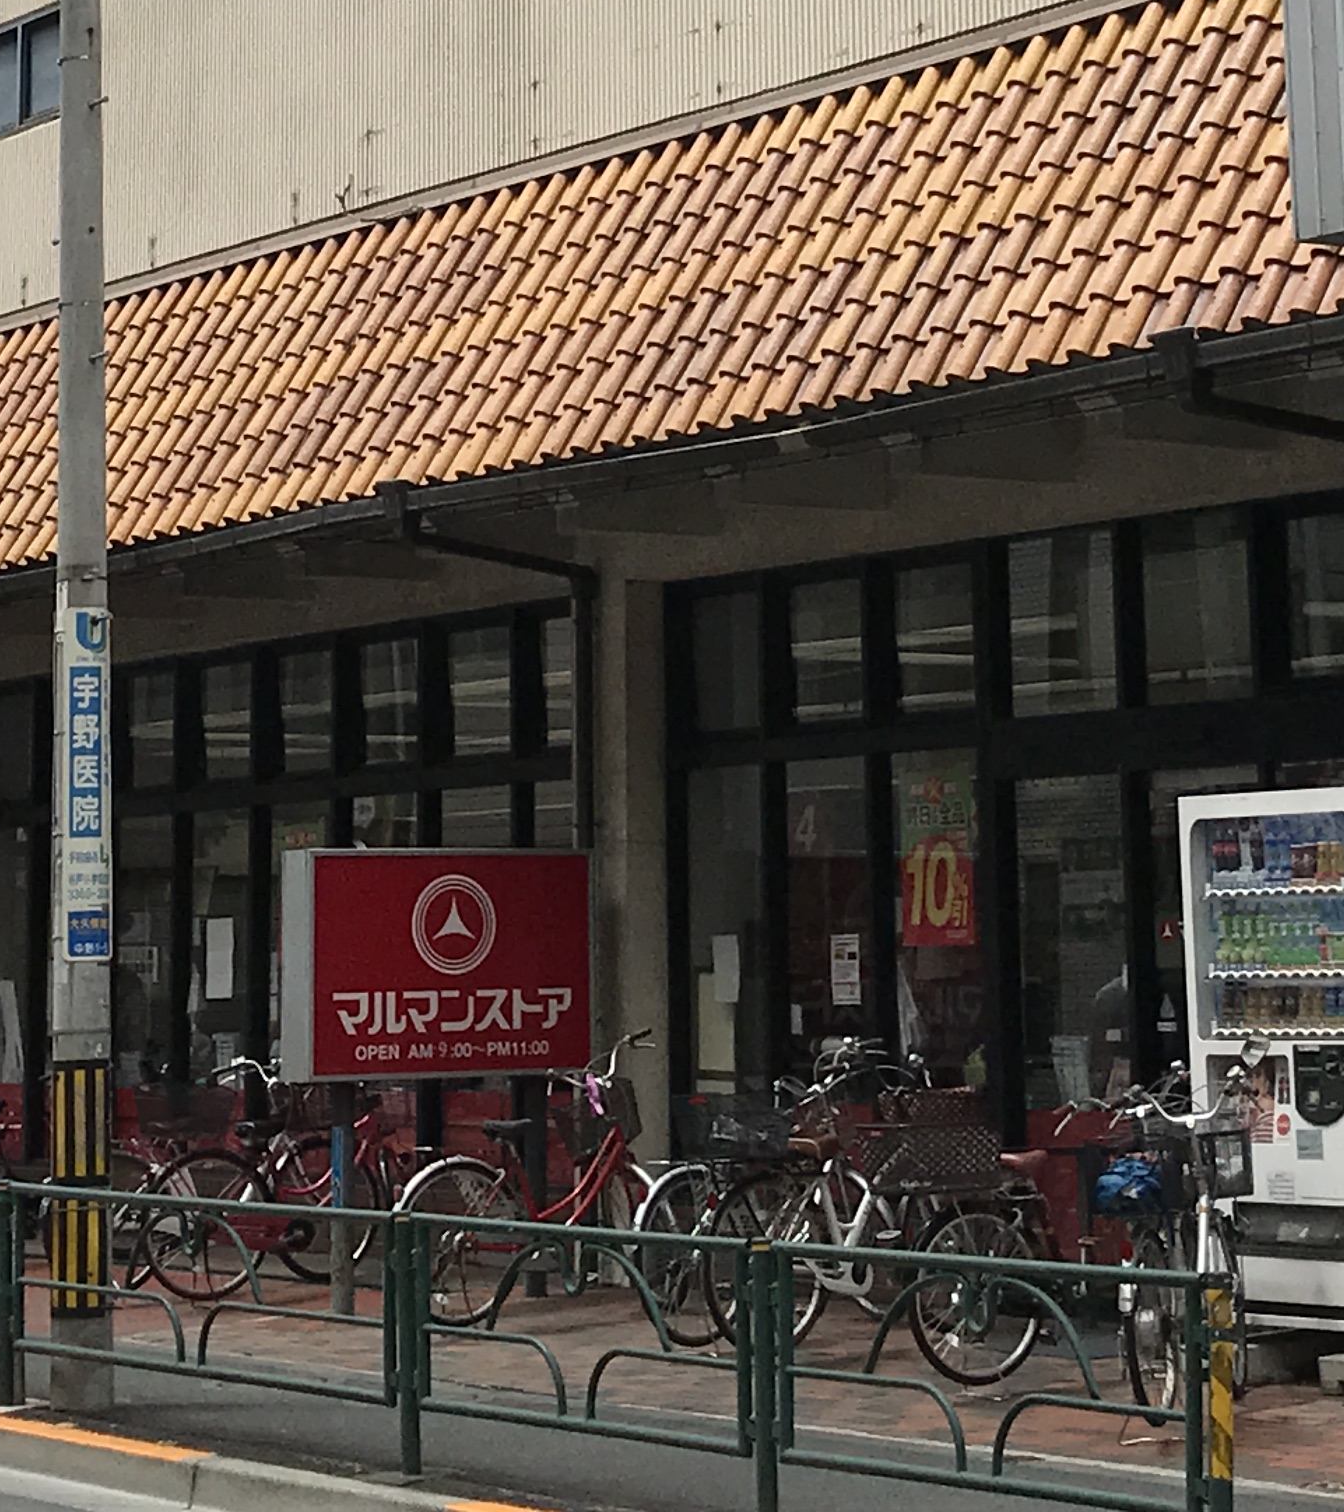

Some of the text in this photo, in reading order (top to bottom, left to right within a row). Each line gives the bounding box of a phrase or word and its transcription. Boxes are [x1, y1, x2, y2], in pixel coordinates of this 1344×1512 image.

[72, 673, 100, 832] 宇野医院
[332, 987, 572, 1035] マルマンストア
[355, 1044, 400, 1061] OPEN
